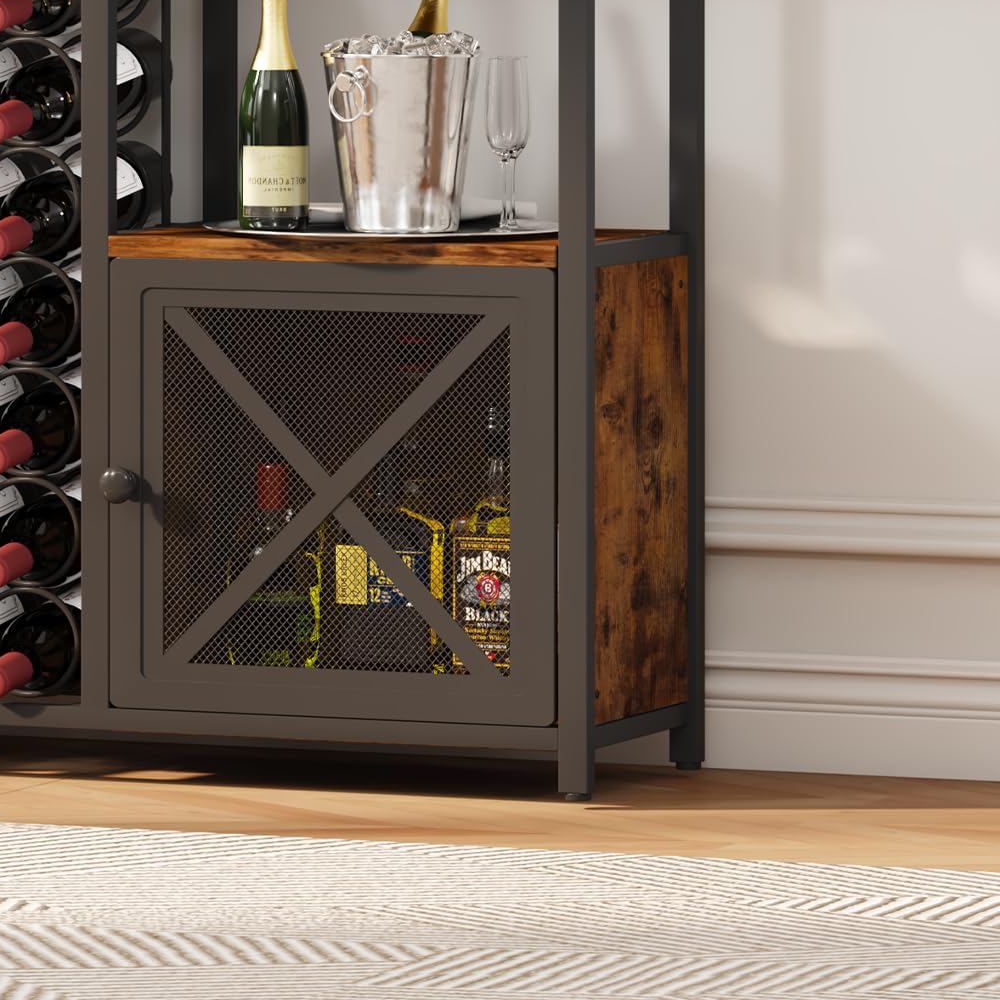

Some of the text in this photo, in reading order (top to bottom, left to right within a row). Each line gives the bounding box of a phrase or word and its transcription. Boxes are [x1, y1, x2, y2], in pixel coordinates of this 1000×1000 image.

[456, 555, 481, 583] JIM
[369, 588, 381, 603] 12
[463, 606, 510, 624] BLACK
